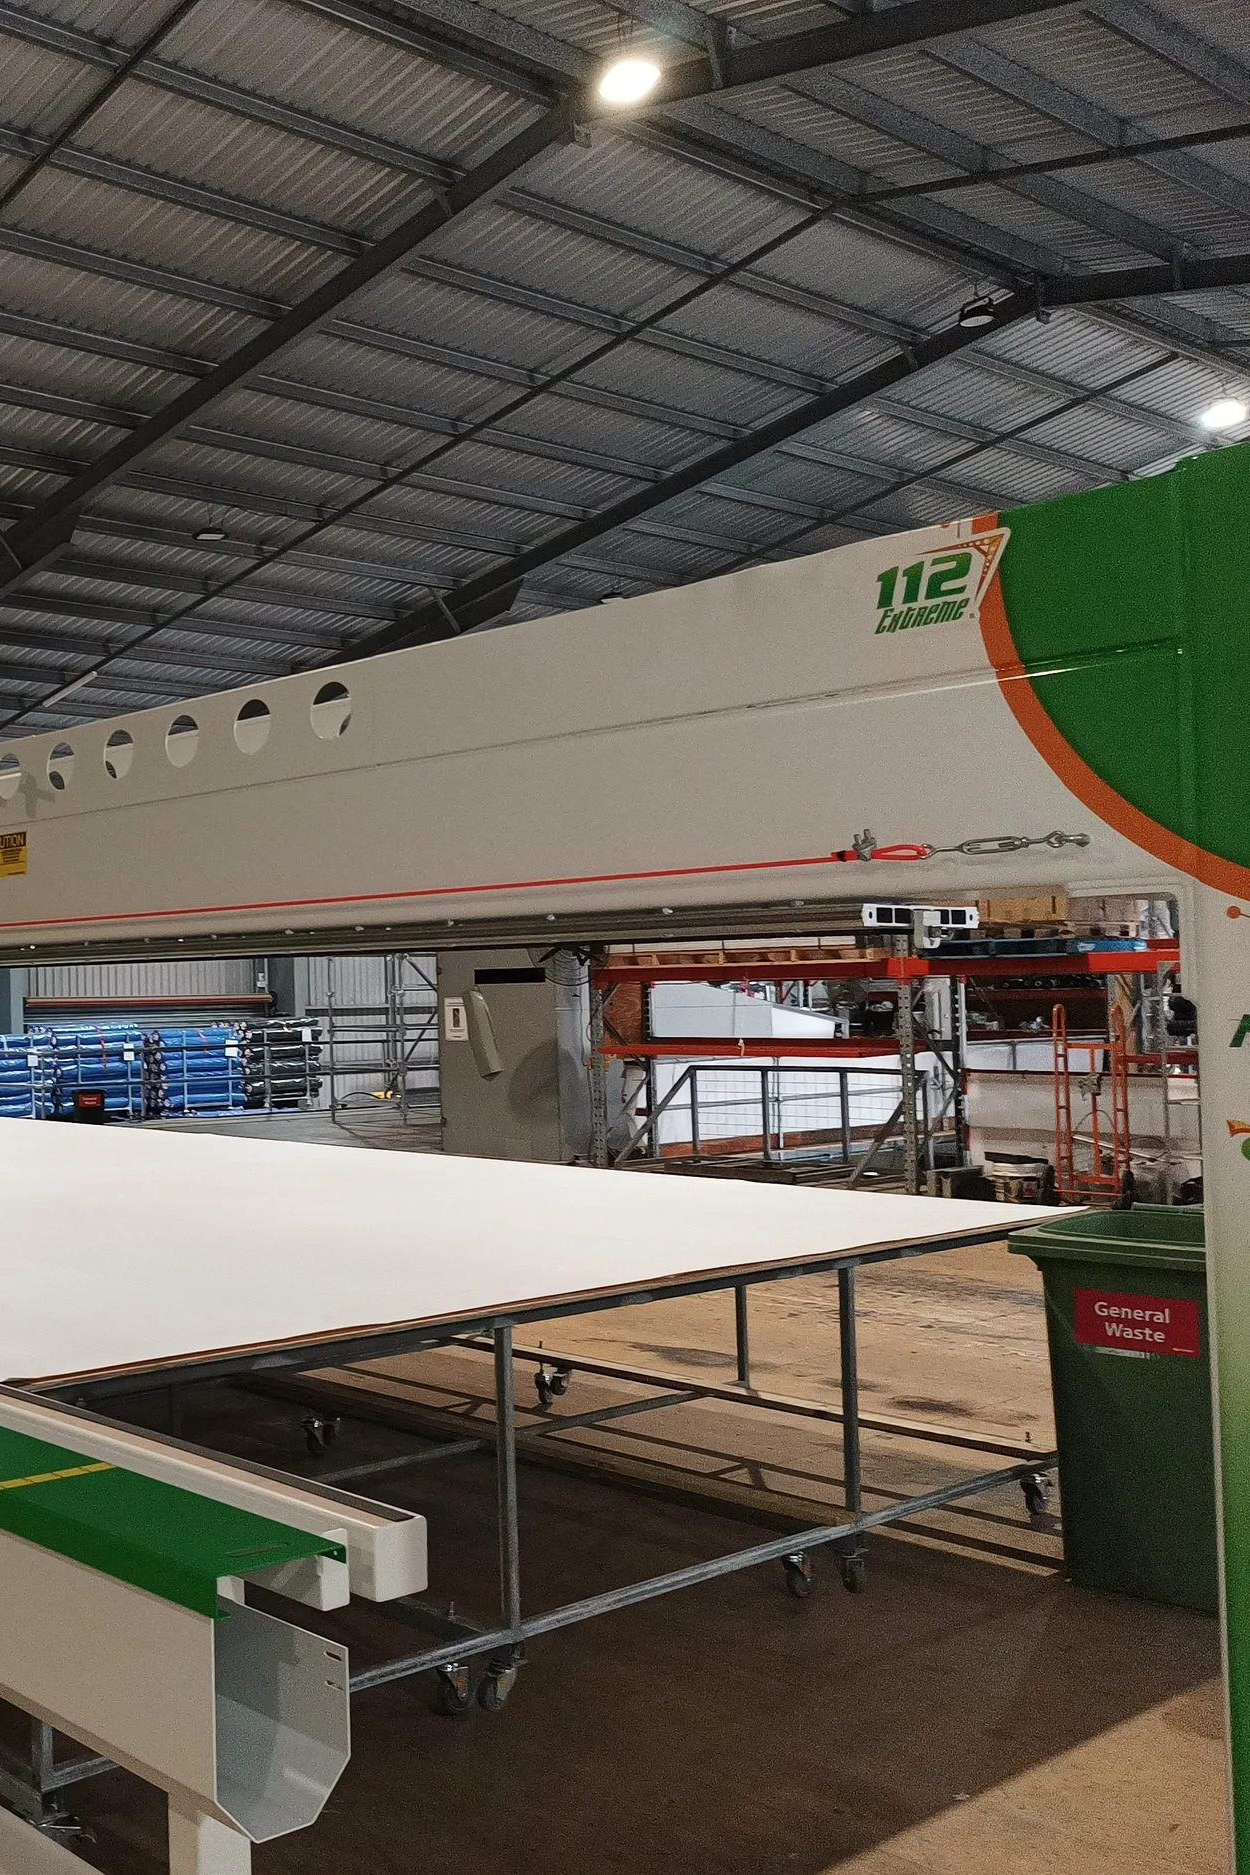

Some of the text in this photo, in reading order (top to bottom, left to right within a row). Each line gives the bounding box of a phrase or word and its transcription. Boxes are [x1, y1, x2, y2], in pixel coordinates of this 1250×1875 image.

[876, 552, 972, 609] 112
[1094, 1301, 1170, 1324] General
[1104, 1322, 1166, 1343] Waste
